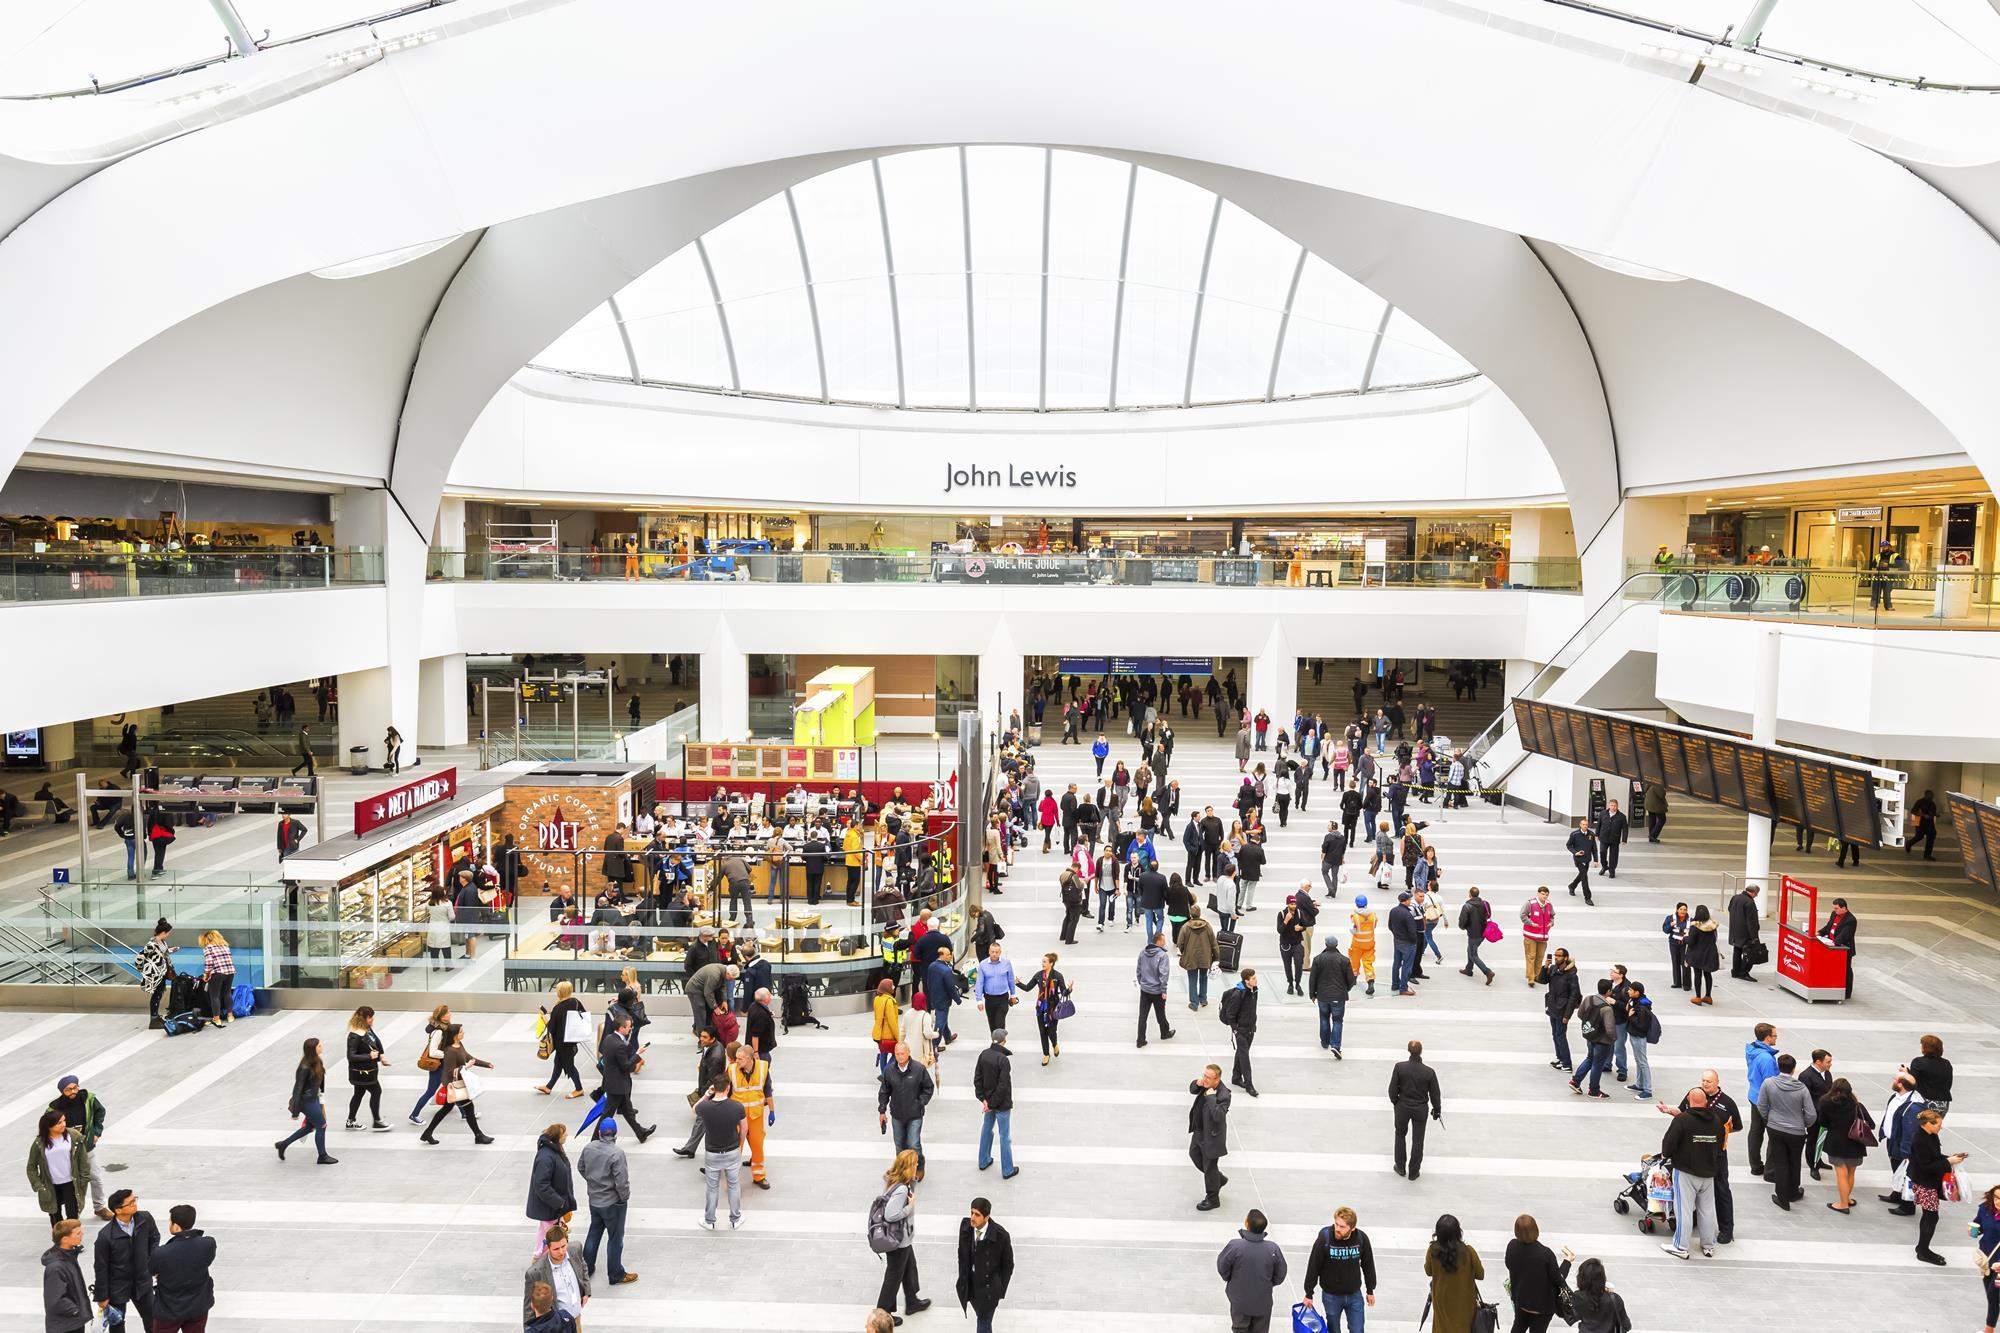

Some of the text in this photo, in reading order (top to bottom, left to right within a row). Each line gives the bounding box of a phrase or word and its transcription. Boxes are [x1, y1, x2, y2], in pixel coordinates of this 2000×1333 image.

[944, 462, 1077, 493] John Lewis
[1424, 524, 1446, 534] ohn
[1018, 559, 1033, 569] THE
[388, 791, 407, 818] PRET
[519, 793, 600, 831] ORGANIC COFFEE
[538, 821, 580, 849] PRET
[521, 845, 571, 875] NATURAL
[57, 871, 64, 881] 7
[1329, 1247, 1360, 1257] BESTIVAL
